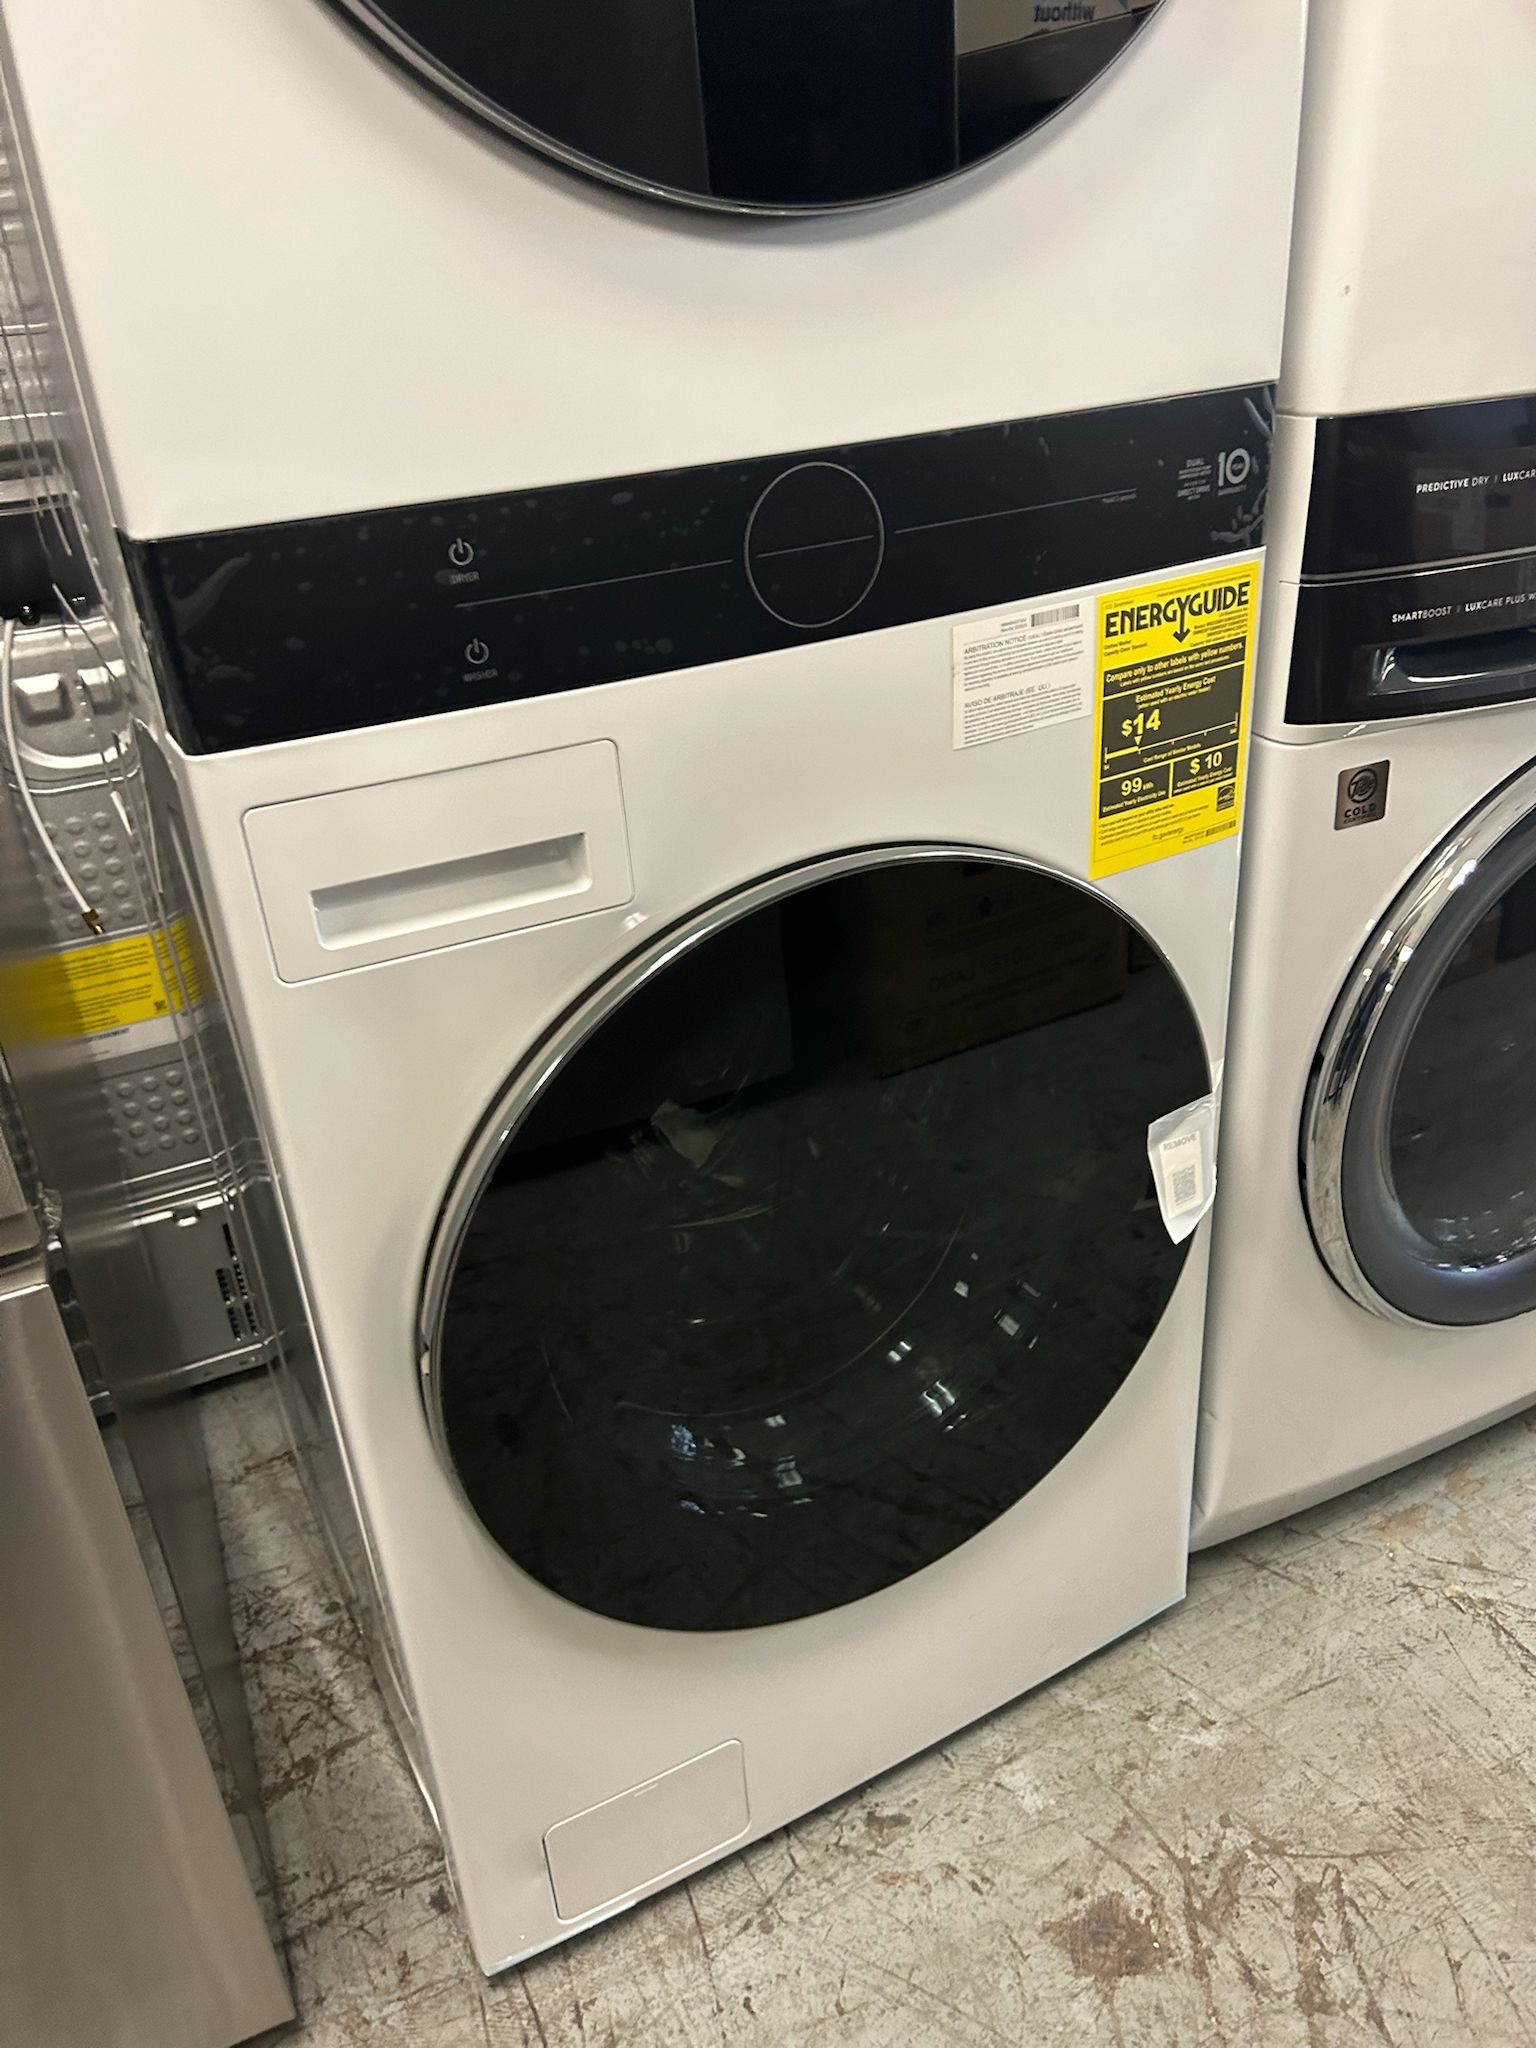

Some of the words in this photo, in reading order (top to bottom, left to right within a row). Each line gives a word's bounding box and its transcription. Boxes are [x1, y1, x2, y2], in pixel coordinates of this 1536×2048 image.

[1415, 478, 1469, 494] PREDICTIVE
[1471, 476, 1490, 487] DRY
[450, 572, 480, 584] DRYER
[1106, 581, 1250, 639] ENERGYGUIDE
[1392, 606, 1452, 623] SMARTBOOST
[1465, 597, 1503, 612] LUXCARE
[1505, 593, 1526, 604] PLUS
[964, 642, 1004, 654] ARBITRATION
[1004, 635, 1026, 646] NOTICE
[1106, 670, 1133, 683] Compare
[1134, 666, 1146, 677] only
[1147, 664, 1154, 672] to
[1154, 660, 1170, 671] other
[1170, 655, 1187, 667] labels
[1188, 652, 1200, 662] with
[1200, 648, 1218, 660] yellow
[1219, 642, 1244, 654] numbers.
[463, 668, 498, 682] WASHER
[993, 689, 1024, 701] ARBITRAJE
[1136, 688, 1164, 703] Estimated
[1165, 684, 1182, 695] Yearly
[1183, 680, 1203, 691] Energy
[1203, 675, 1216, 685] Cost
[1121, 708, 1161, 736] $14
[1189, 758, 1200, 775] $
[1205, 751, 1223, 769] 10
[1121, 777, 1142, 796] 99
[1344, 803, 1376, 818] COLD
[1163, 1133, 1197, 1151] REMOVE
